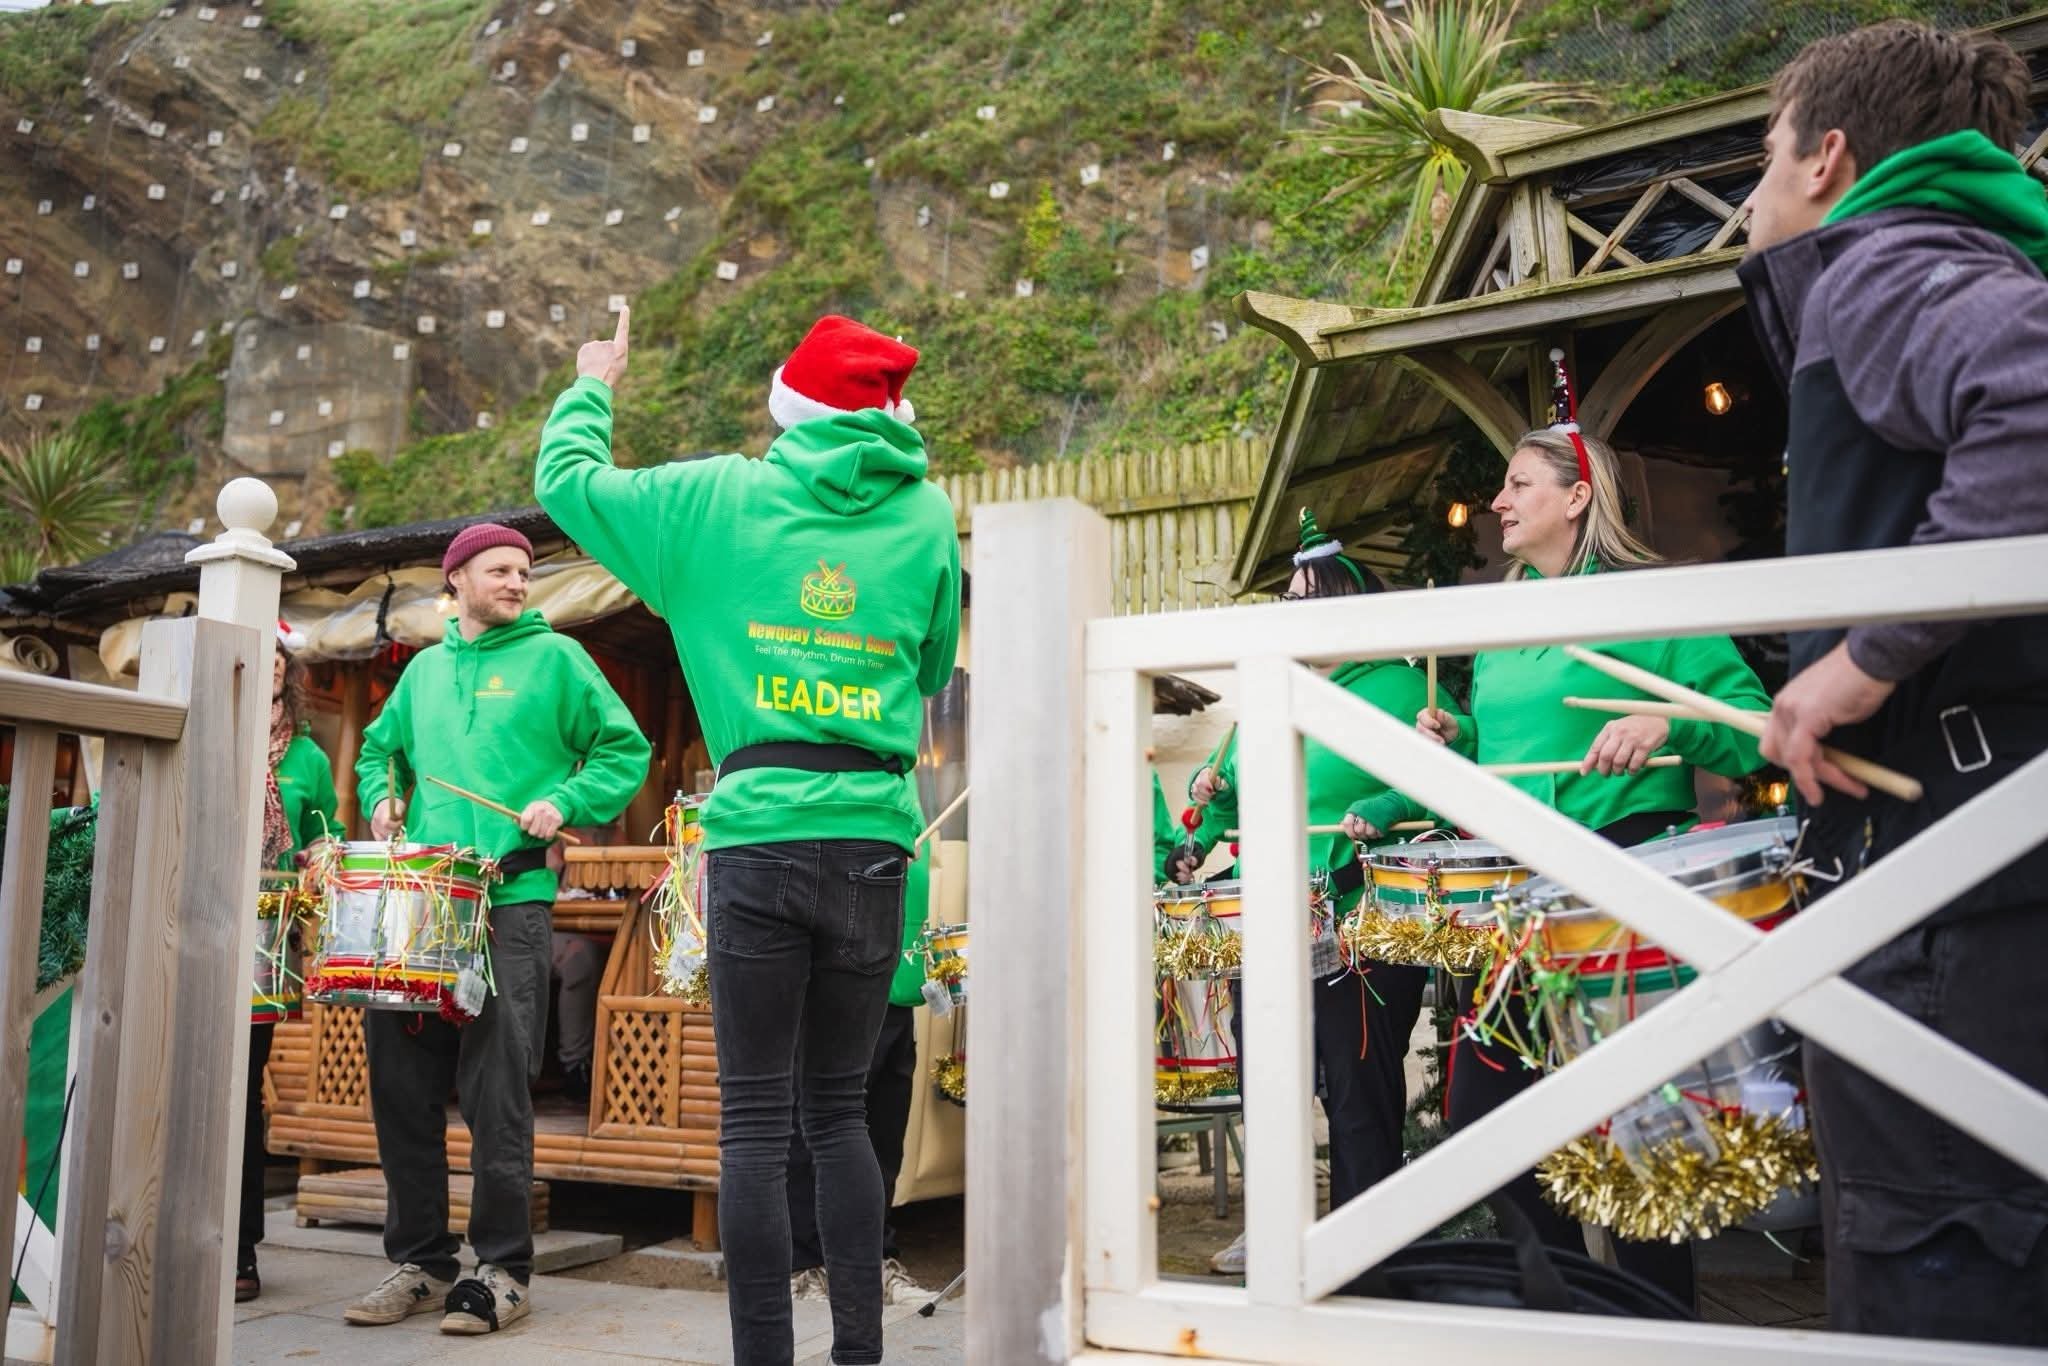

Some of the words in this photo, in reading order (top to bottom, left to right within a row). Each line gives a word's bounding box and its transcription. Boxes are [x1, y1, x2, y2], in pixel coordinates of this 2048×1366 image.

[748, 621, 810, 644] Newquay
[814, 628, 862, 651] Samba
[755, 645, 771, 655] Feel
[773, 646, 788, 656] The
[791, 648, 827, 662] Rhythm,
[831, 653, 856, 665] Drum
[755, 674, 881, 721] LEADER
